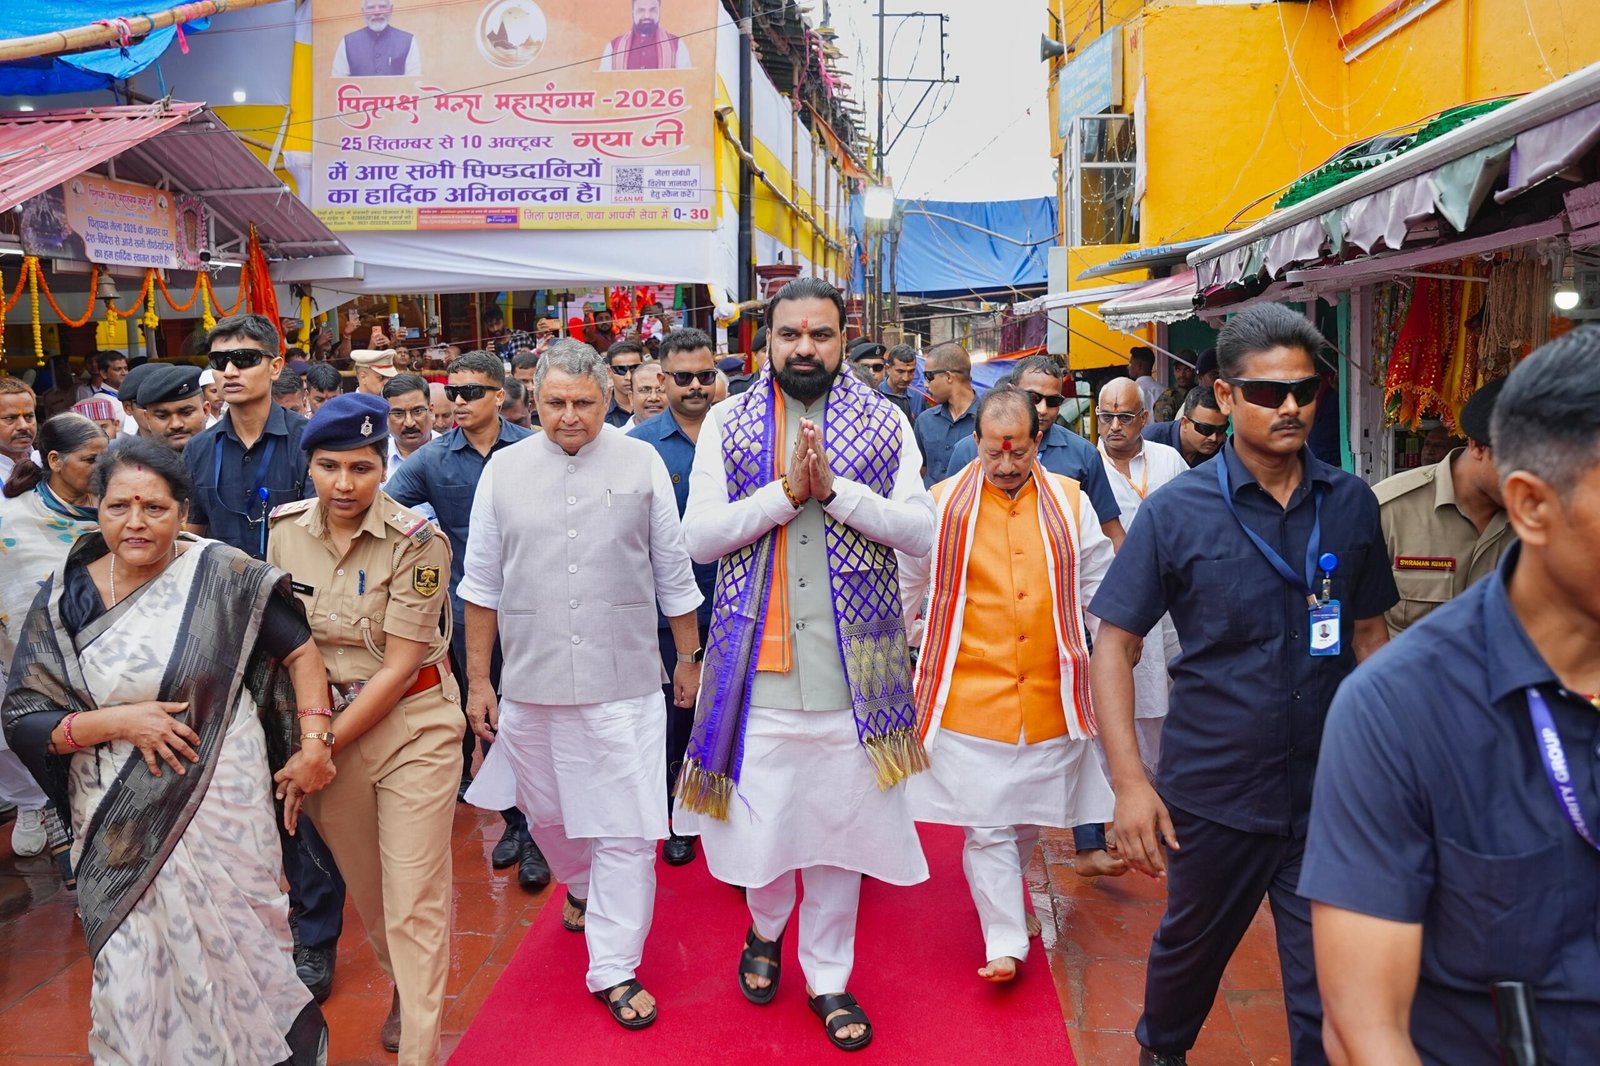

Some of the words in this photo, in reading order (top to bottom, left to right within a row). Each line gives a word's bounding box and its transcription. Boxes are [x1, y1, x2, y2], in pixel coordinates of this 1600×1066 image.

[338, 84, 420, 129] पितृपक्ष
[420, 86, 500, 124] मेला
[341, 137, 362, 150] 25
[367, 135, 434, 150] सितम्बर
[438, 134, 455, 149] से
[461, 135, 482, 149] 10
[487, 135, 554, 151] अक्टूबर
[572, 131, 634, 158] गया
[641, 118, 685, 147] जी
[328, 161, 349, 180] में
[355, 165, 400, 180] आए
[405, 159, 457, 181] सभी
[463, 158, 603, 179] पिण्डदानियों
[655, 168, 670, 177] मेला
[328, 189, 360, 204] का
[365, 183, 438, 204] हार्दिक
[444, 182, 570, 204] अभिनन्दन
[576, 181, 601, 203] है।
[648, 179, 666, 188] विशेष
[667, 179, 698, 188] जानकारी
[523, 209, 544, 220] जिला
[587, 210, 605, 220] गया
[608, 208, 636, 220] आपकी
[640, 208, 657, 220] सेवा
[661, 208, 669, 219] में
[690, 208, 709, 220] 30
[88, 216, 109, 231] पितृपक्ष
[110, 220, 123, 231] मेला
[123, 223, 137, 233] 2026
[161, 229, 169, 237] पर
[94, 249, 103, 258] का
[1541, 727, 1570, 784] GROUP
